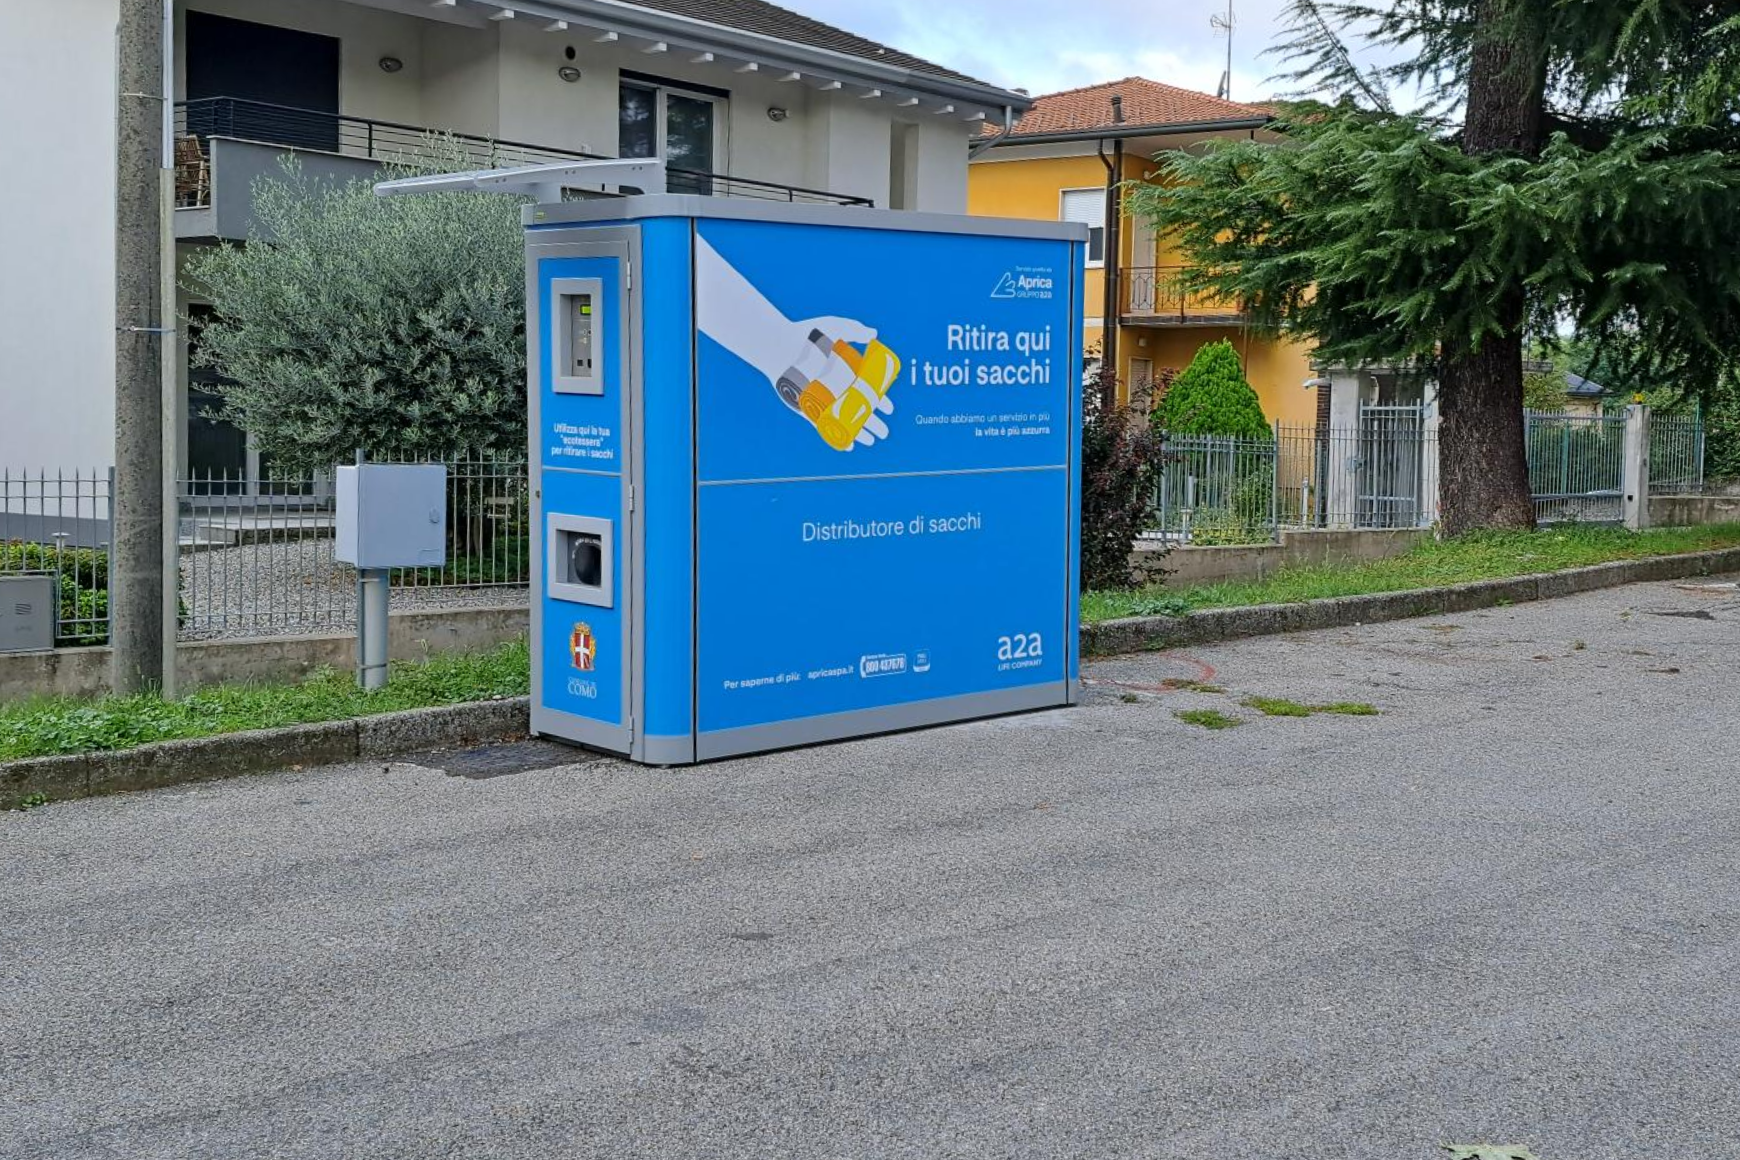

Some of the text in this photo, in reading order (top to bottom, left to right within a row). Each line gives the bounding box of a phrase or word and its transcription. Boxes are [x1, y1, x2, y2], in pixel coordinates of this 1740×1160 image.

[1017, 274, 1053, 291] Aprica
[947, 324, 1050, 357] Ritira qui
[911, 358, 1050, 386] i tuoi sacchi
[915, 411, 1050, 425] Quando abbiamo un servizio in più
[553, 423, 578, 433] Utilizza
[578, 424, 590, 437] qui
[598, 426, 611, 437] tua
[975, 427, 983, 437] la
[984, 426, 999, 437] vita
[1007, 426, 1020, 437] più
[1021, 426, 1051, 435] azzurra
[551, 446, 562, 457] per
[563, 445, 586, 457] ritirare
[591, 448, 614, 459] sacchi
[802, 511, 981, 542] Distributore di sacchi
[997, 632, 1043, 660] a2a
[1011, 658, 1043, 670] COMPANY
[723, 680, 739, 690] Per
[740, 676, 774, 689] saperne
[775, 674, 784, 684] di
[567, 683, 597, 699] COMO
